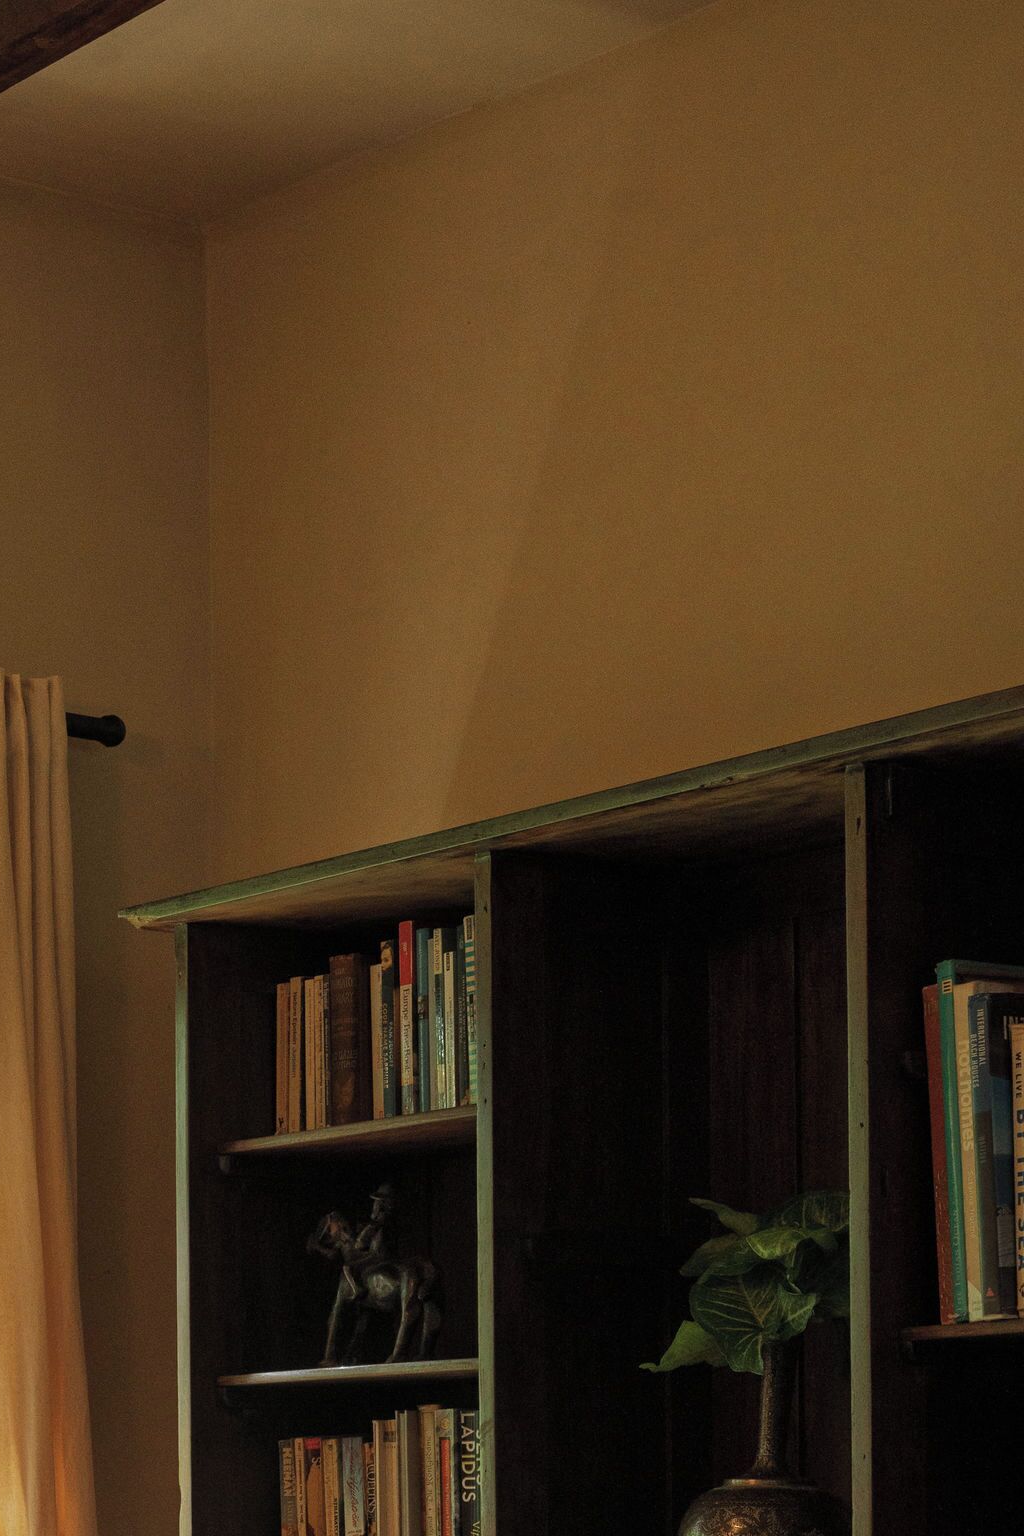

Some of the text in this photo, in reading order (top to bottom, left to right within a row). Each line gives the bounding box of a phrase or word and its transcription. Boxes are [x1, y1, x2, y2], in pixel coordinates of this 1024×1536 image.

[970, 1033, 980, 1089] BEACH HOUSES
[976, 1008, 986, 1066] INTERNATIONAL
[1015, 1051, 1022, 1069] WE
[460, 1411, 477, 1503] LAPIDUS
